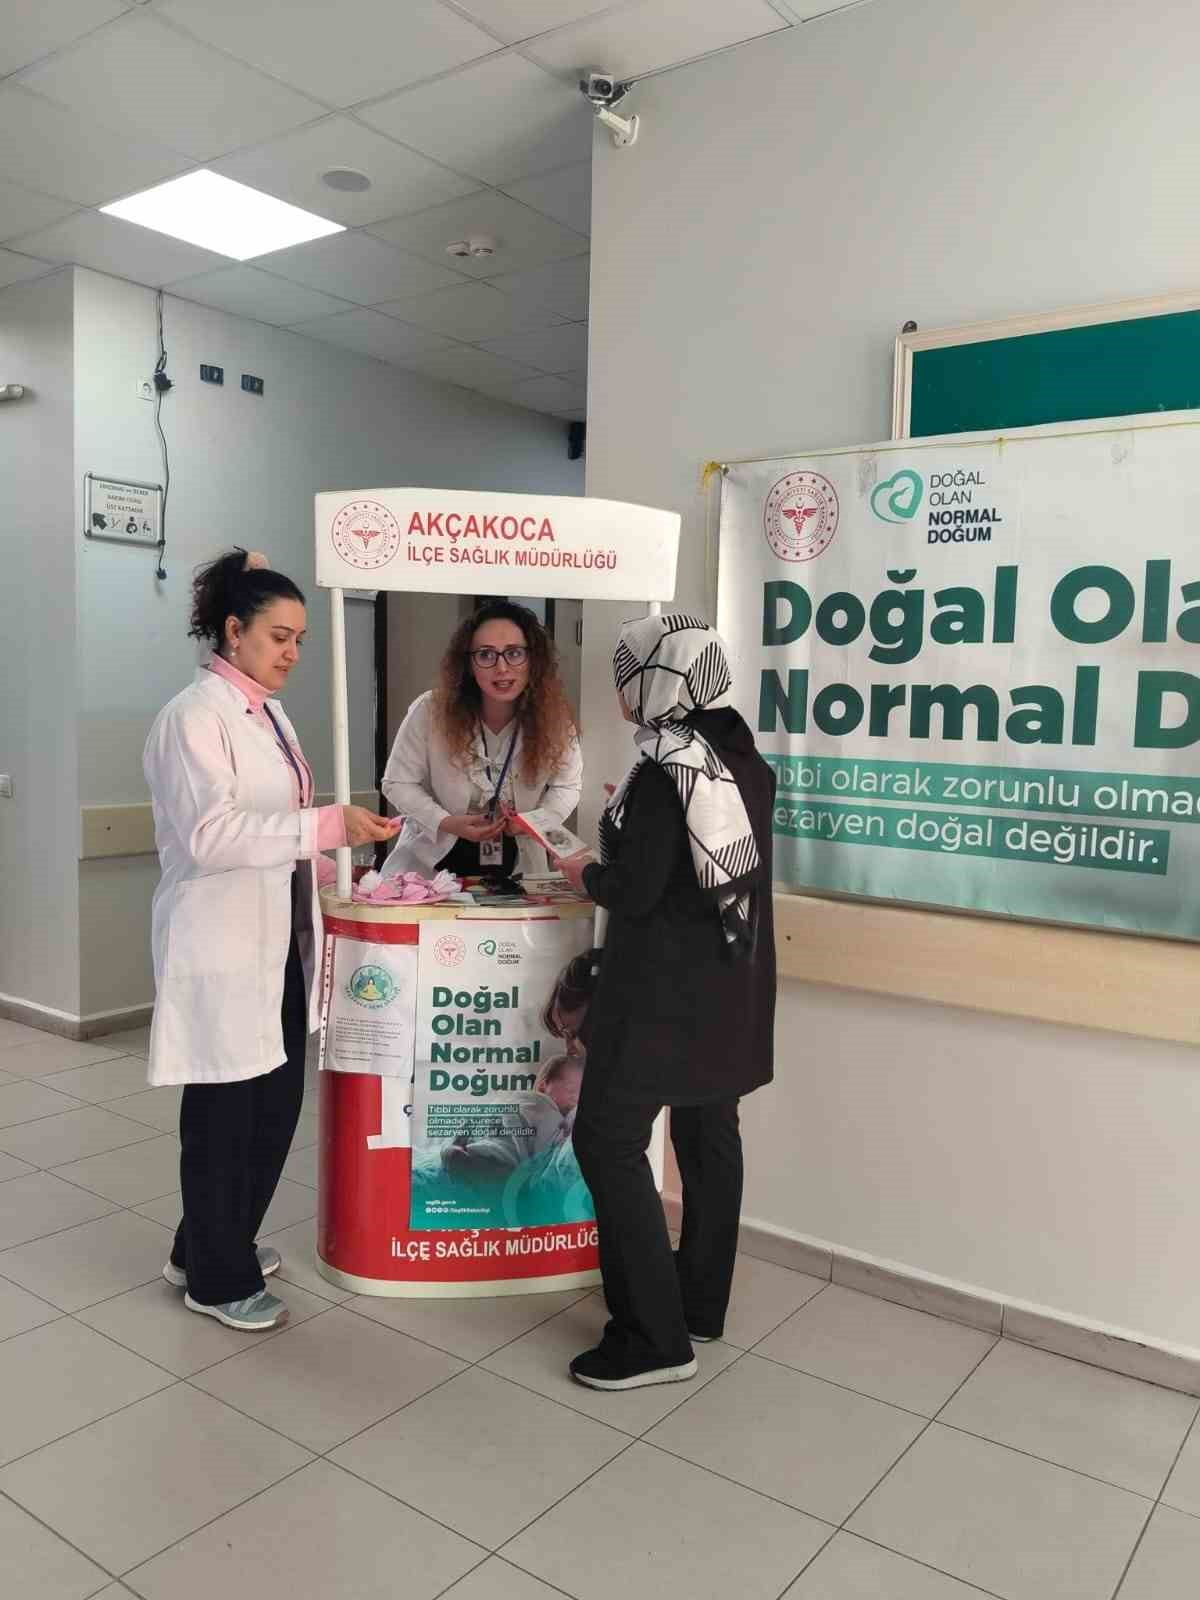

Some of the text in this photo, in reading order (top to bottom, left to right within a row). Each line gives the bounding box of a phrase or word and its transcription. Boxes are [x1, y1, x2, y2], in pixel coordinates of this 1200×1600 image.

[930, 469, 985, 488] DOĞAL
[929, 490, 972, 506] OLAN
[407, 511, 556, 543] AKÇAKOCA
[928, 507, 1002, 526] NORMAL
[927, 525, 992, 544] DOĞUM
[407, 541, 617, 570] İLÇE SAĞLIK MÜDÜRLÜĞÜ
[762, 565, 1018, 665] Doğal
[758, 665, 1100, 746] Normal
[831, 765, 931, 796] olarak
[942, 775, 1080, 808] zorunlu
[773, 806, 1159, 864] ezaryen doğal değildir.
[432, 985, 519, 1014] Doğal
[431, 1013, 501, 1036] Olan
[430, 1040, 541, 1063] Normal
[429, 1068, 537, 1097] Doğum
[435, 1238, 500, 1258] SAĞLIK
[505, 1226, 600, 1256] MÜDÜRLÜĞ
